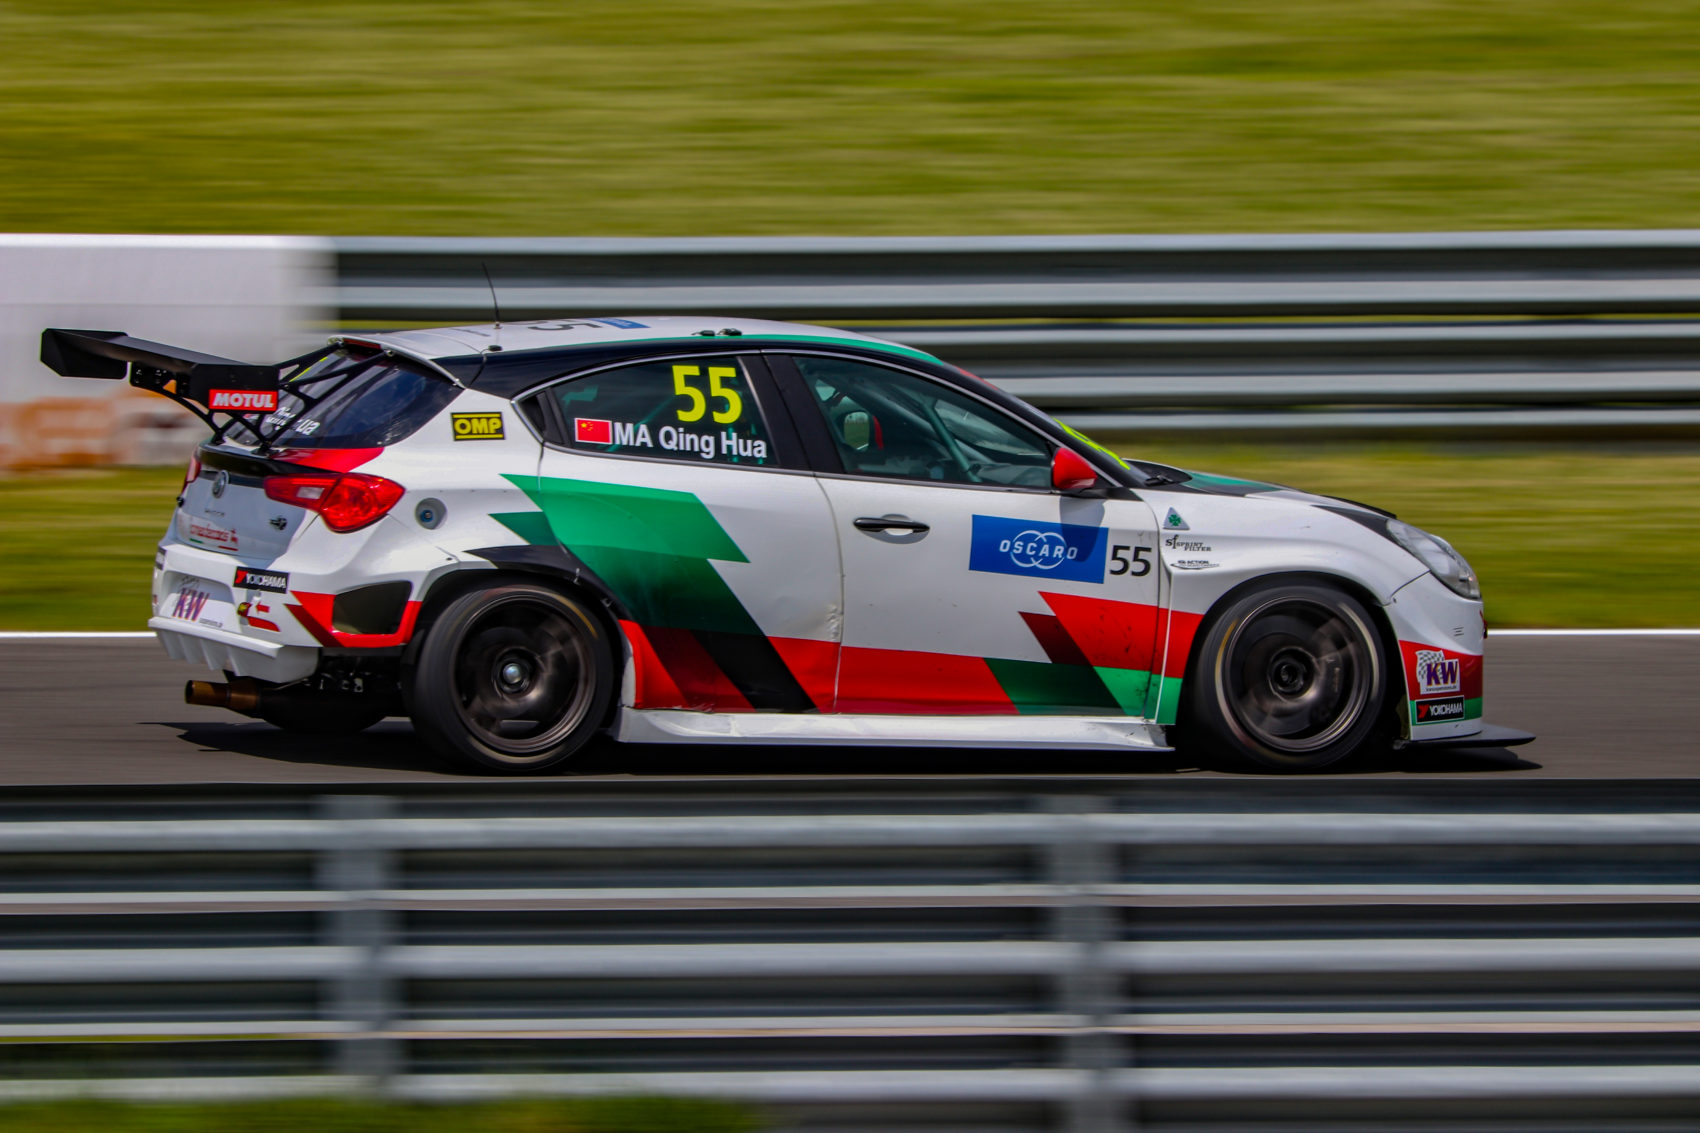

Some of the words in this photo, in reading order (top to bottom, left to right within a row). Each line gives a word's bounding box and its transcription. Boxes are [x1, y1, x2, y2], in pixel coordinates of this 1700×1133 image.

[212, 392, 275, 408] MOTUL
[672, 365, 743, 424] 55
[454, 417, 502, 435] OMP
[613, 421, 653, 448] MA
[658, 425, 715, 459] Qing
[720, 431, 767, 458] Hua
[1000, 539, 1079, 560] OSCARO
[1109, 544, 1152, 577] 55
[246, 572, 288, 589] YOKOHAMA
[172, 587, 210, 622] KW
[1426, 660, 1459, 687] KW
[1429, 701, 1463, 716] YOKOHAMA
